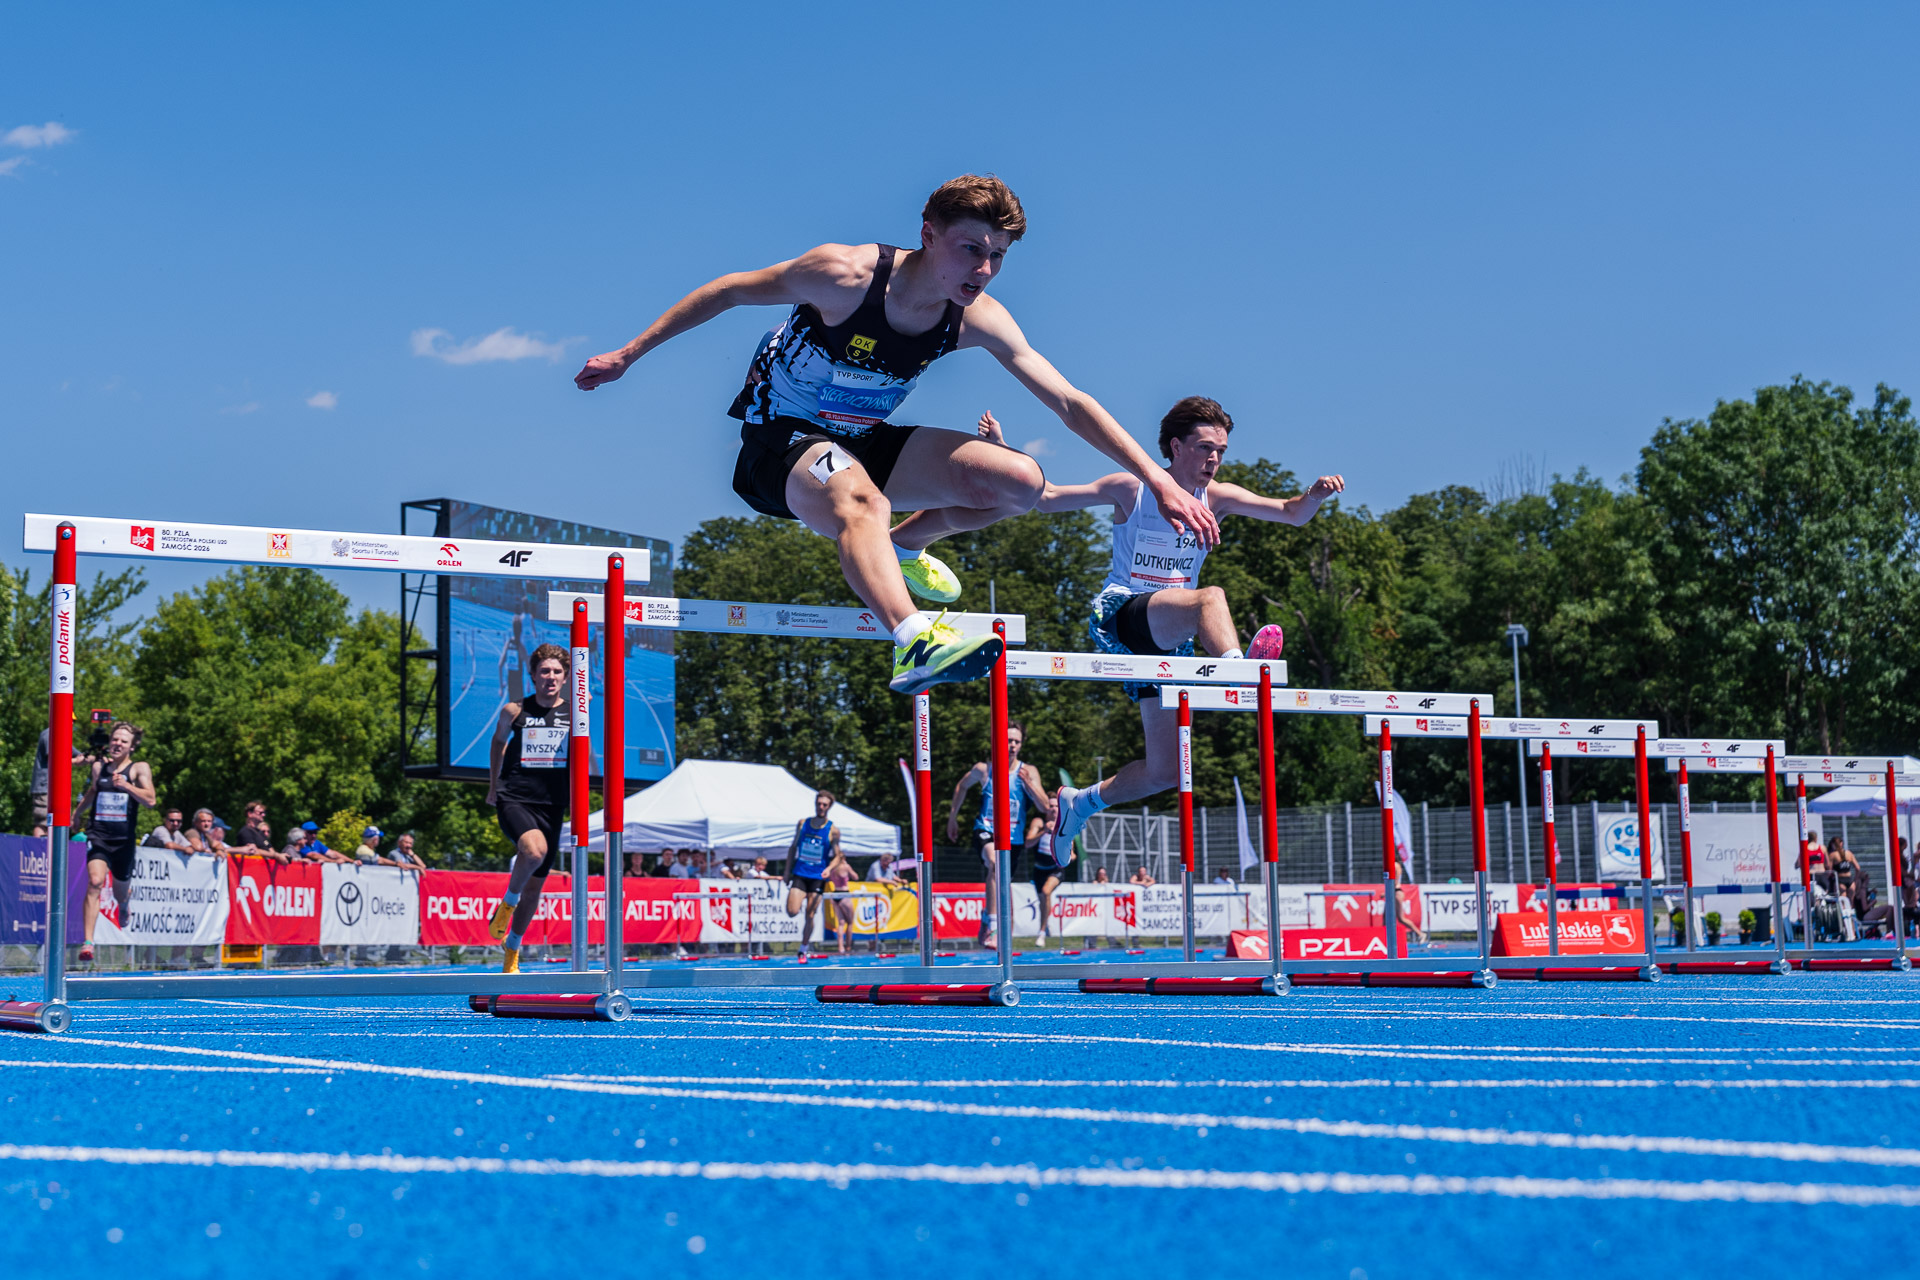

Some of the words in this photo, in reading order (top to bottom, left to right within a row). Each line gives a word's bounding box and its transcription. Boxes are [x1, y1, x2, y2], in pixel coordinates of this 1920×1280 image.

[836, 370, 851, 378] TVP
[852, 373, 874, 382] SPORT
[816, 450, 835, 473] 7
[162, 543, 192, 551] ZAMOŚĆ
[352, 540, 388, 548] Ministerstwo
[1175, 537, 1196, 548] 194
[375, 548, 400, 556] Turystyki
[499, 550, 533, 567] 4F
[1134, 552, 1194, 570] DUTKIEWICZ
[57, 609, 71, 665] polanik
[1195, 664, 1217, 677] 4F
[576, 668, 588, 714] polanik
[1418, 698, 1437, 709] 4F
[918, 713, 929, 751] polanik
[1588, 725, 1605, 734] 4F
[526, 744, 564, 753] RYSZKA
[1726, 744, 1740, 753] 4F
[1705, 844, 1767, 861] Zamość
[149, 861, 171, 881] PZLA
[131, 886, 180, 903] MISTRZOSTWA
[182, 888, 205, 904] POLSKI
[264, 885, 315, 917] ORLEN
[1157, 890, 1176, 901] PZLA
[371, 897, 406, 917] Okęcie
[428, 896, 483, 920] POLSKI
[625, 900, 695, 921] ATLETYKI
[1431, 900, 1459, 914] TVP
[1464, 900, 1509, 914] SPRT
[130, 908, 172, 934] ZAMOŚĆ
[174, 914, 195, 934] 2026
[779, 921, 798, 934] 2026
[1142, 915, 1180, 929] ZAMOŚĆ
[1300, 936, 1388, 957] PZLA
